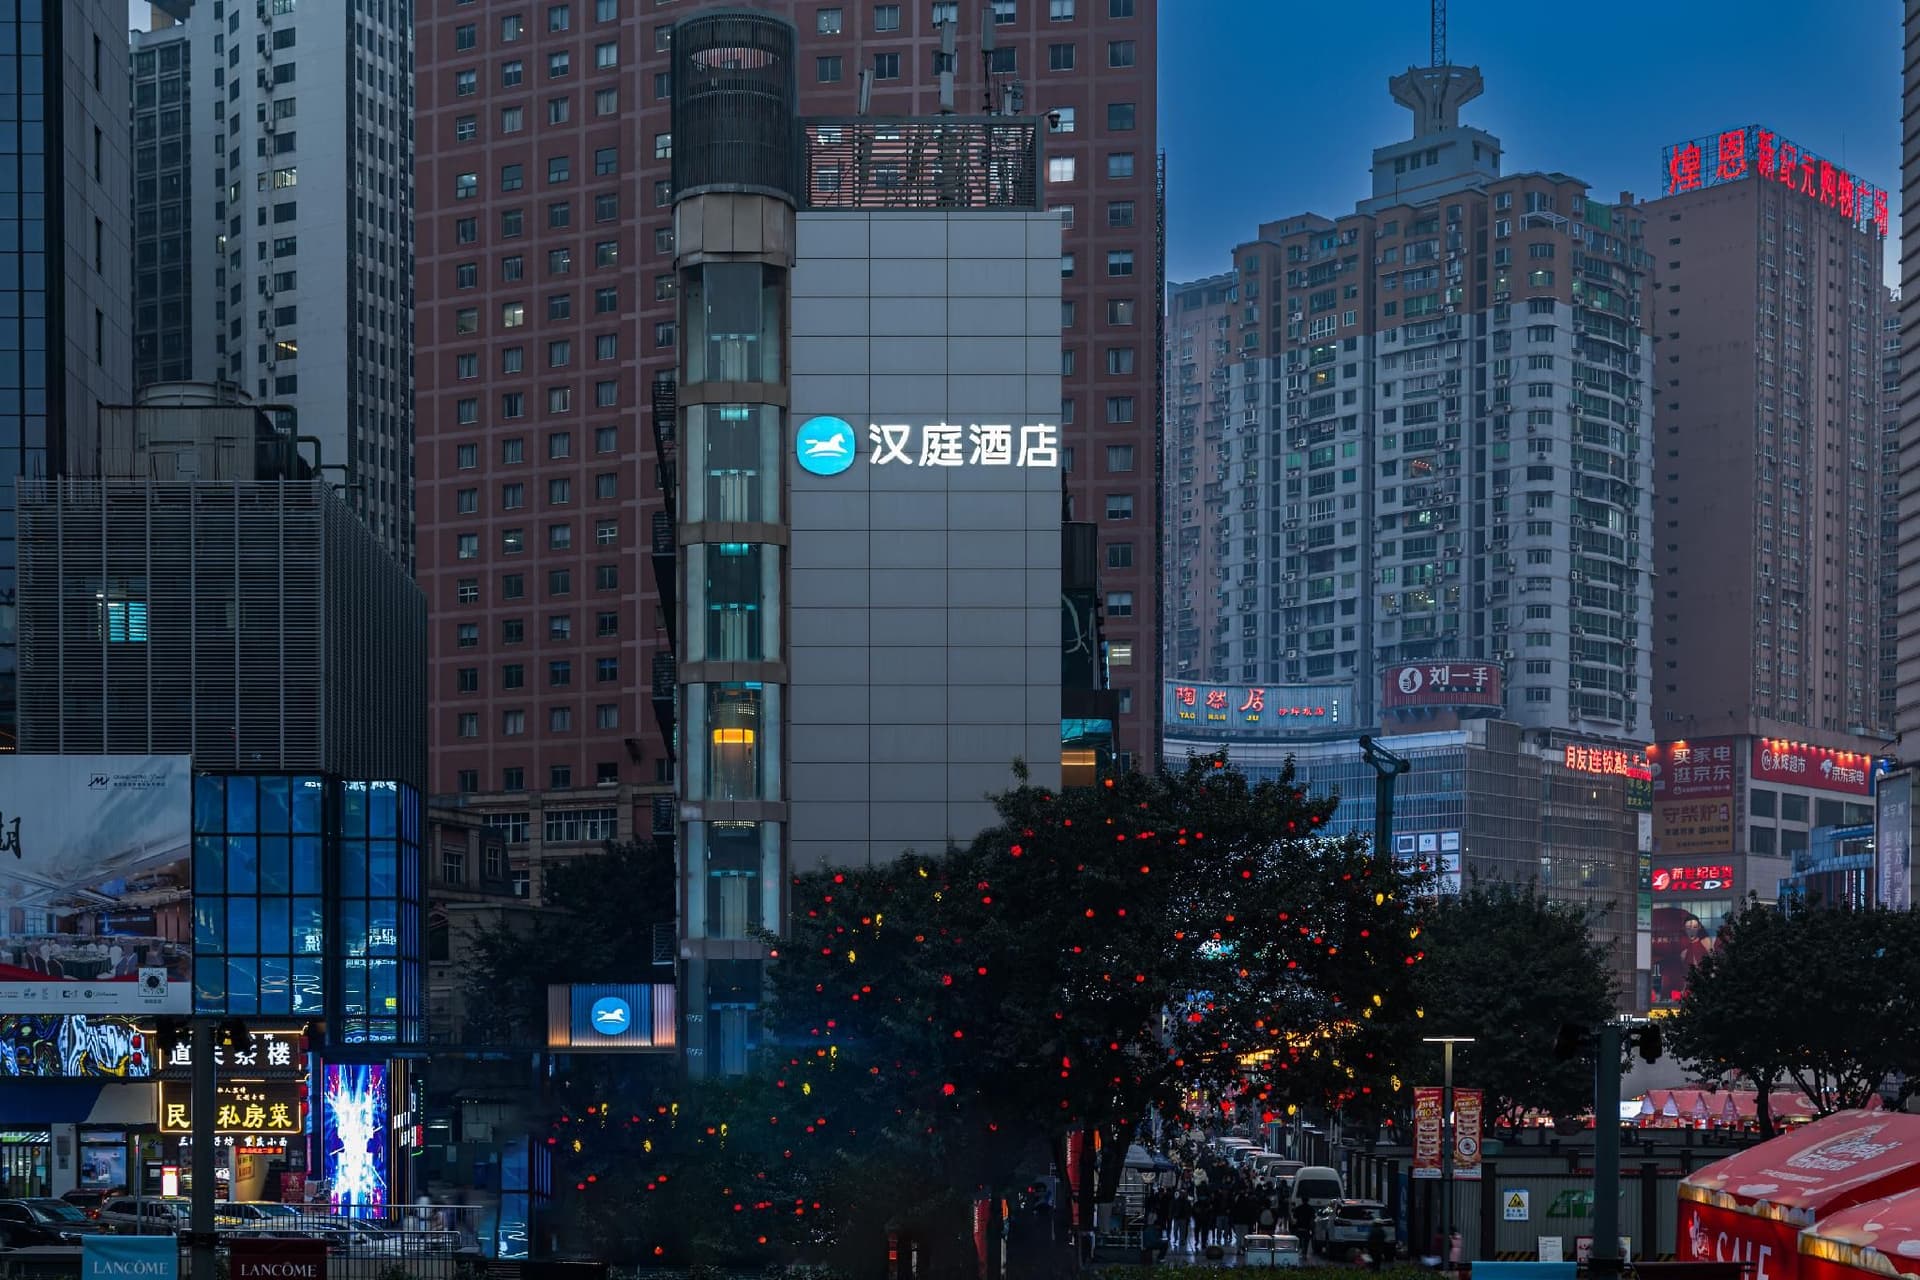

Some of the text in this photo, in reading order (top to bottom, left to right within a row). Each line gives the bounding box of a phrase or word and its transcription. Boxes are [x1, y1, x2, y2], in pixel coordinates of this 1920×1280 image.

[1757, 128, 1889, 237] 新纪元购物广场
[869, 422, 1058, 468] 汉庭酒店
[1429, 665, 1488, 687] 刘一手
[1175, 686, 1265, 713] 陶然居
[1179, 711, 1196, 720] TAO
[1673, 745, 1731, 766] 买家电
[1771, 752, 1807, 774] 永辉超市
[1673, 765, 1731, 783] 逛京东
[1832, 766, 1865, 786] 京东家电
[1671, 865, 1734, 881] 新世纪百货
[167, 1103, 293, 1129] 民私房菜
[93, 1259, 169, 1275] LANCÔME
[240, 1262, 318, 1278] LANCÔME
